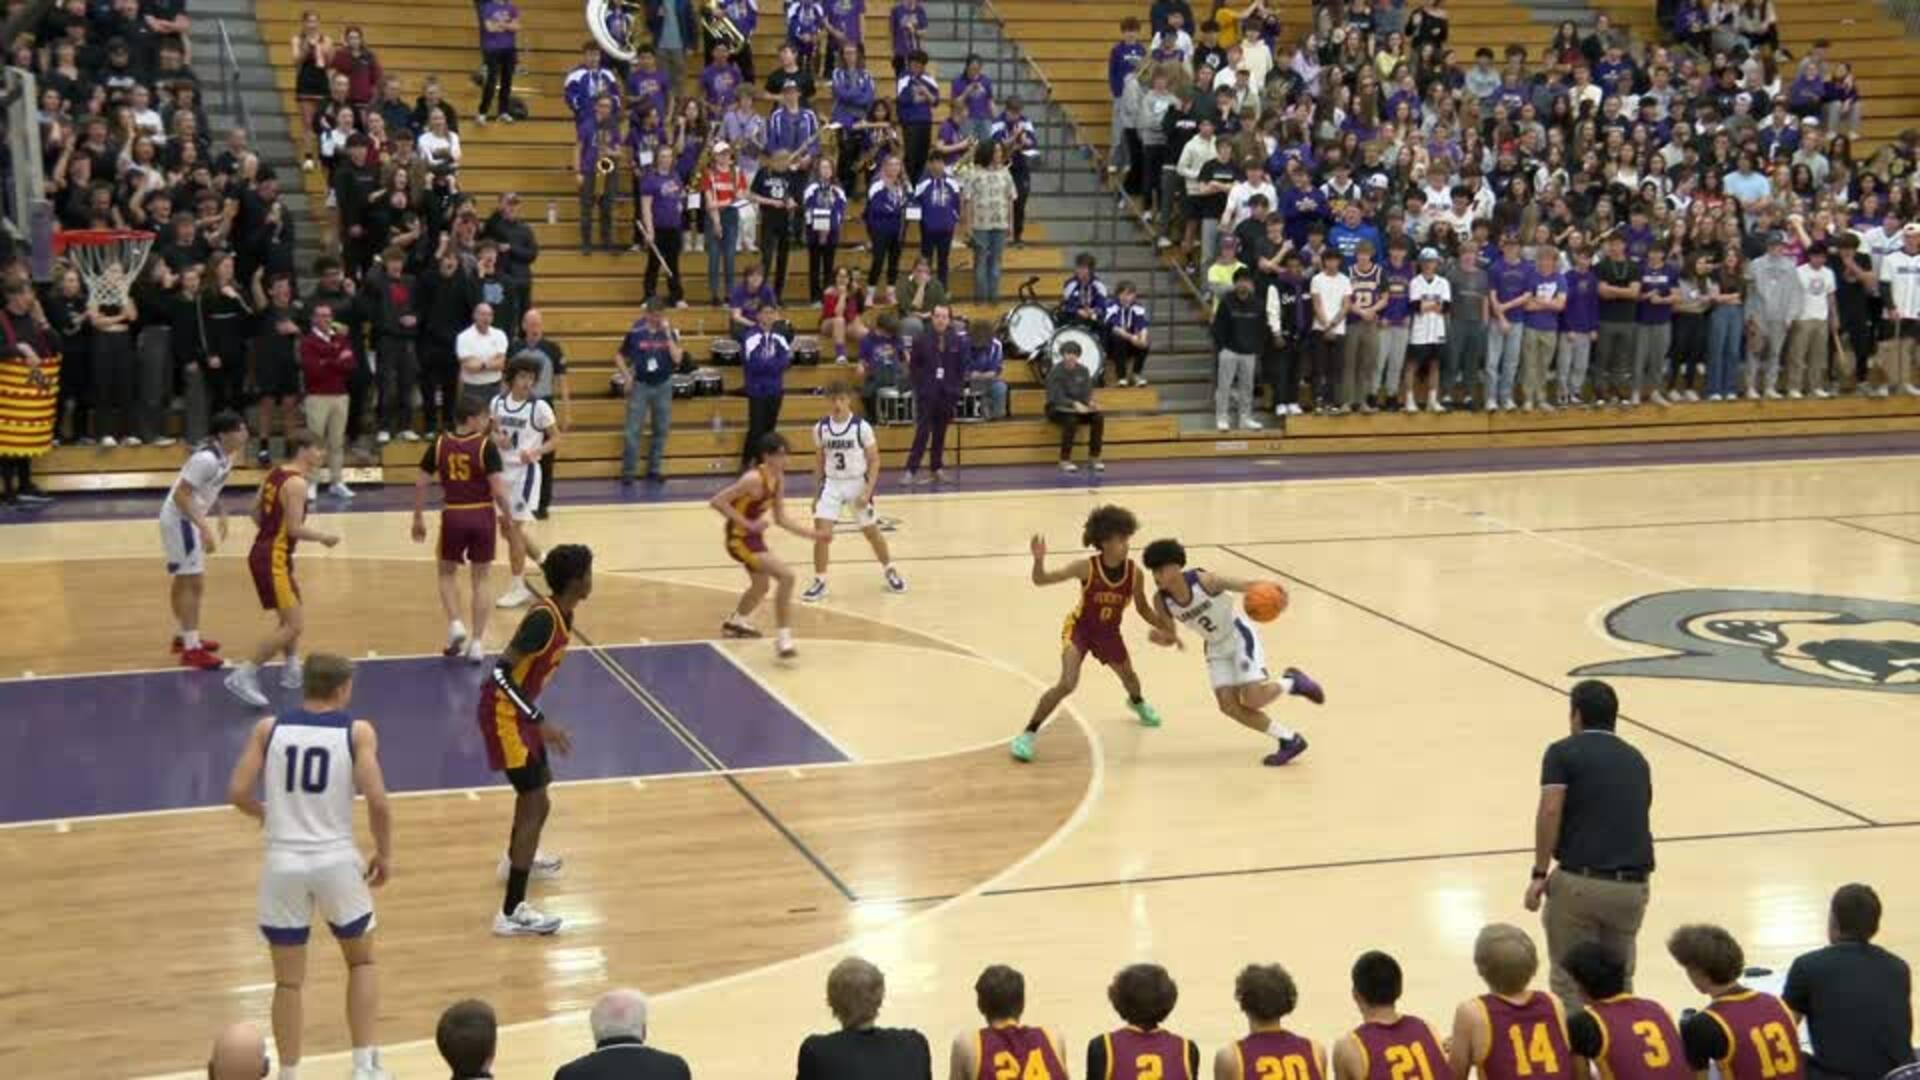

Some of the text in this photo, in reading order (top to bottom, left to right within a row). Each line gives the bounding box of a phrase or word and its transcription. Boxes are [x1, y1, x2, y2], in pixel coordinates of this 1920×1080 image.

[447, 453, 471, 482] 15
[833, 452, 846, 471] 3
[1198, 615, 1217, 633] 2
[284, 745, 331, 794] 10
[1384, 1041, 1435, 1080] 21
[1508, 1023, 1560, 1075] 14
[1632, 1020, 1671, 1067] 3
[1749, 1022, 1797, 1078] 13
